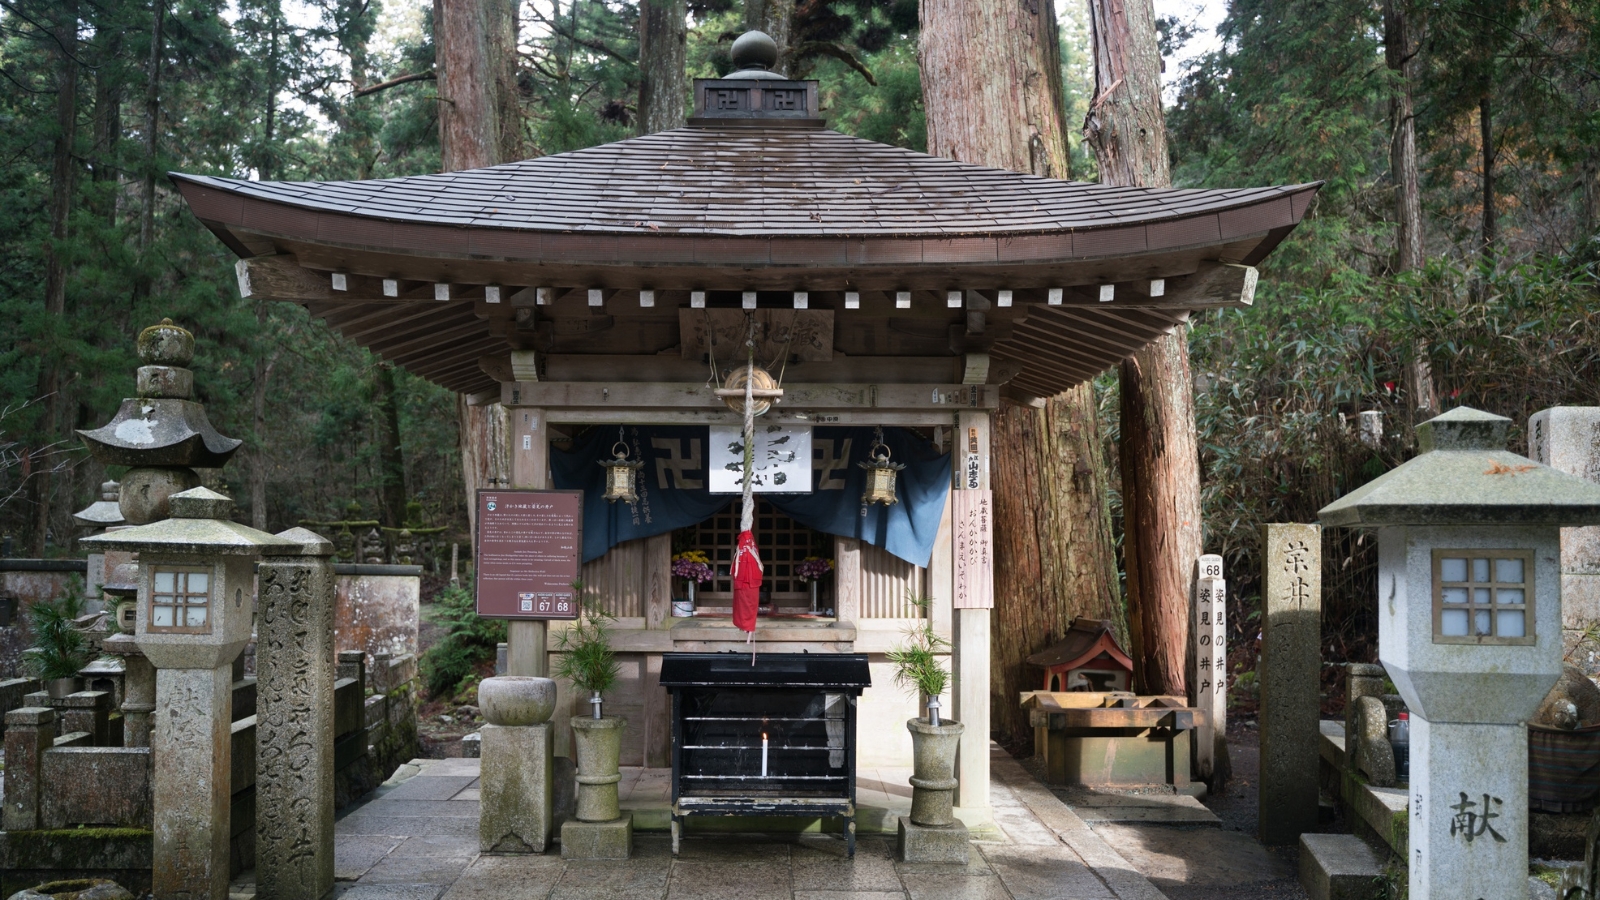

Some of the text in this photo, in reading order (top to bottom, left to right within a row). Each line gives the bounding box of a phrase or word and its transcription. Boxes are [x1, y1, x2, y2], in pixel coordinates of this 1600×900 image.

[1206, 564, 1220, 576] 68
[539, 601, 551, 612] 67
[557, 602, 569, 612] 68
[1199, 588, 1211, 694] 姿見の井戸
[1215, 588, 1224, 694] 姿見の井戸
[1449, 791, 1508, 843] 献
